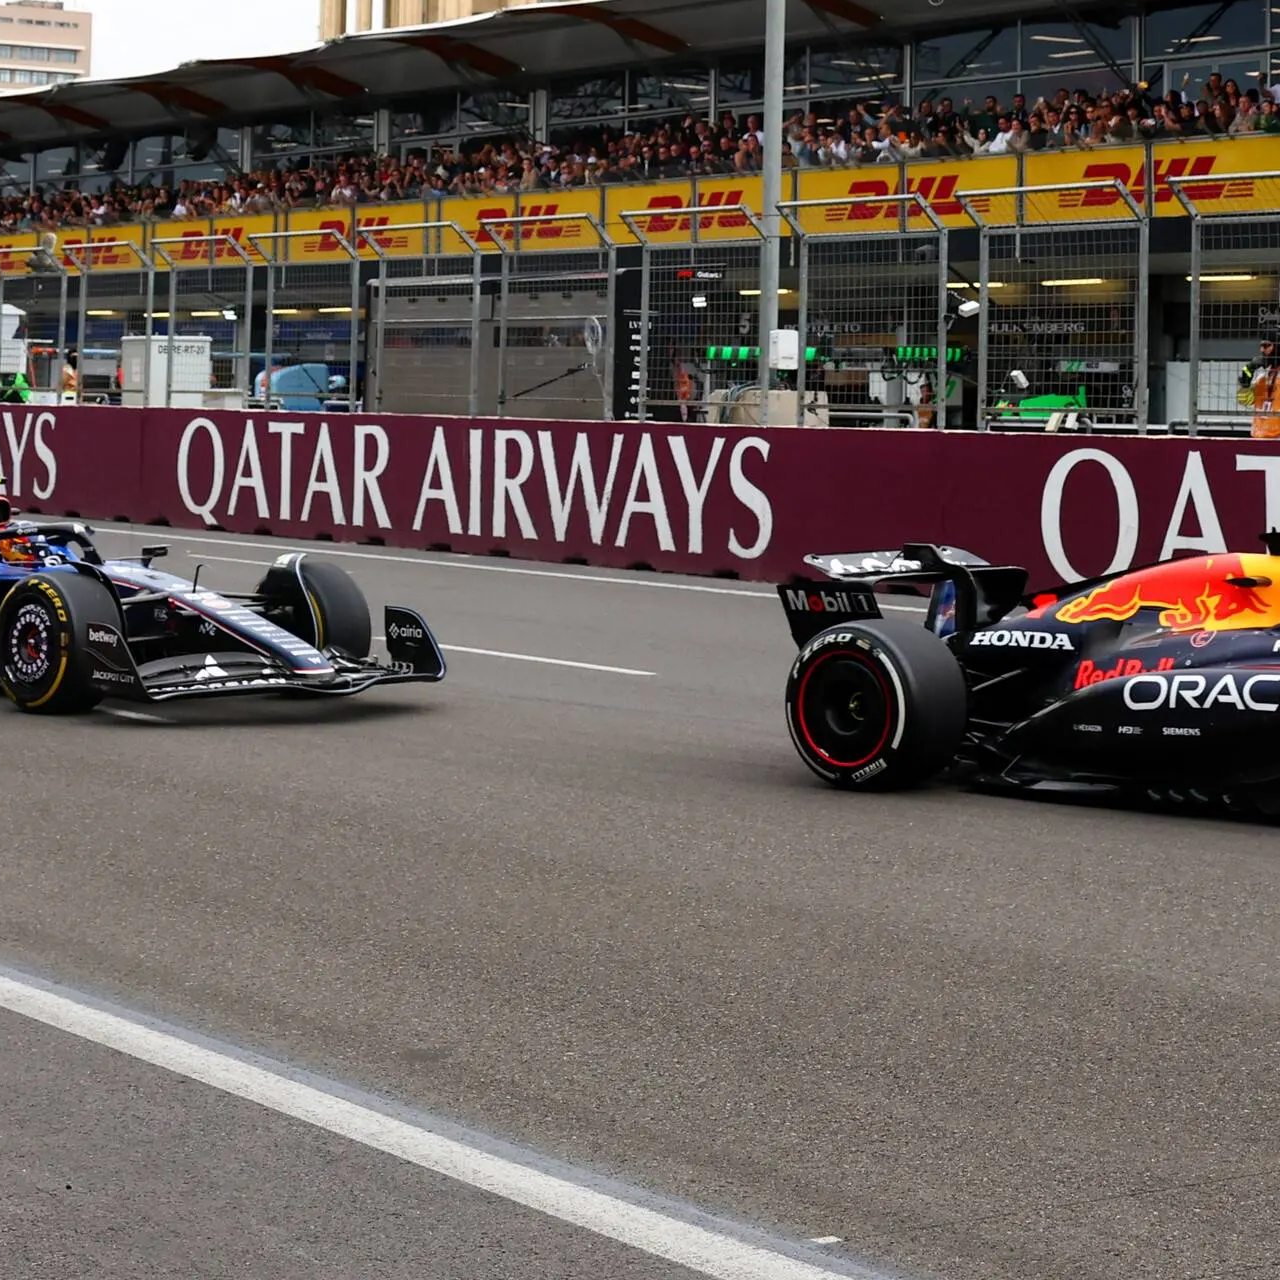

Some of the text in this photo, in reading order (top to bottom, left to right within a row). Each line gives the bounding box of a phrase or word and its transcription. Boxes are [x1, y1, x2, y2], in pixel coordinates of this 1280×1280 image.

[845, 174, 973, 220] DHL
[1081, 156, 1226, 208] DHL
[476, 204, 562, 242] DHL
[647, 190, 748, 233] DHL
[64, 236, 119, 266] DHL
[181, 227, 245, 260] DHL
[318, 217, 394, 252] DHL
[176, 417, 774, 560] QATAR AIRWAYS
[38, 584, 67, 622] ZERO
[787, 589, 869, 613] Mobil 1
[88, 628, 118, 647] betway
[400, 626, 423, 639] airia
[803, 632, 853, 662] ZERO
[970, 630, 1075, 651] HONDA
[1162, 726, 1201, 736] SIEMENS
